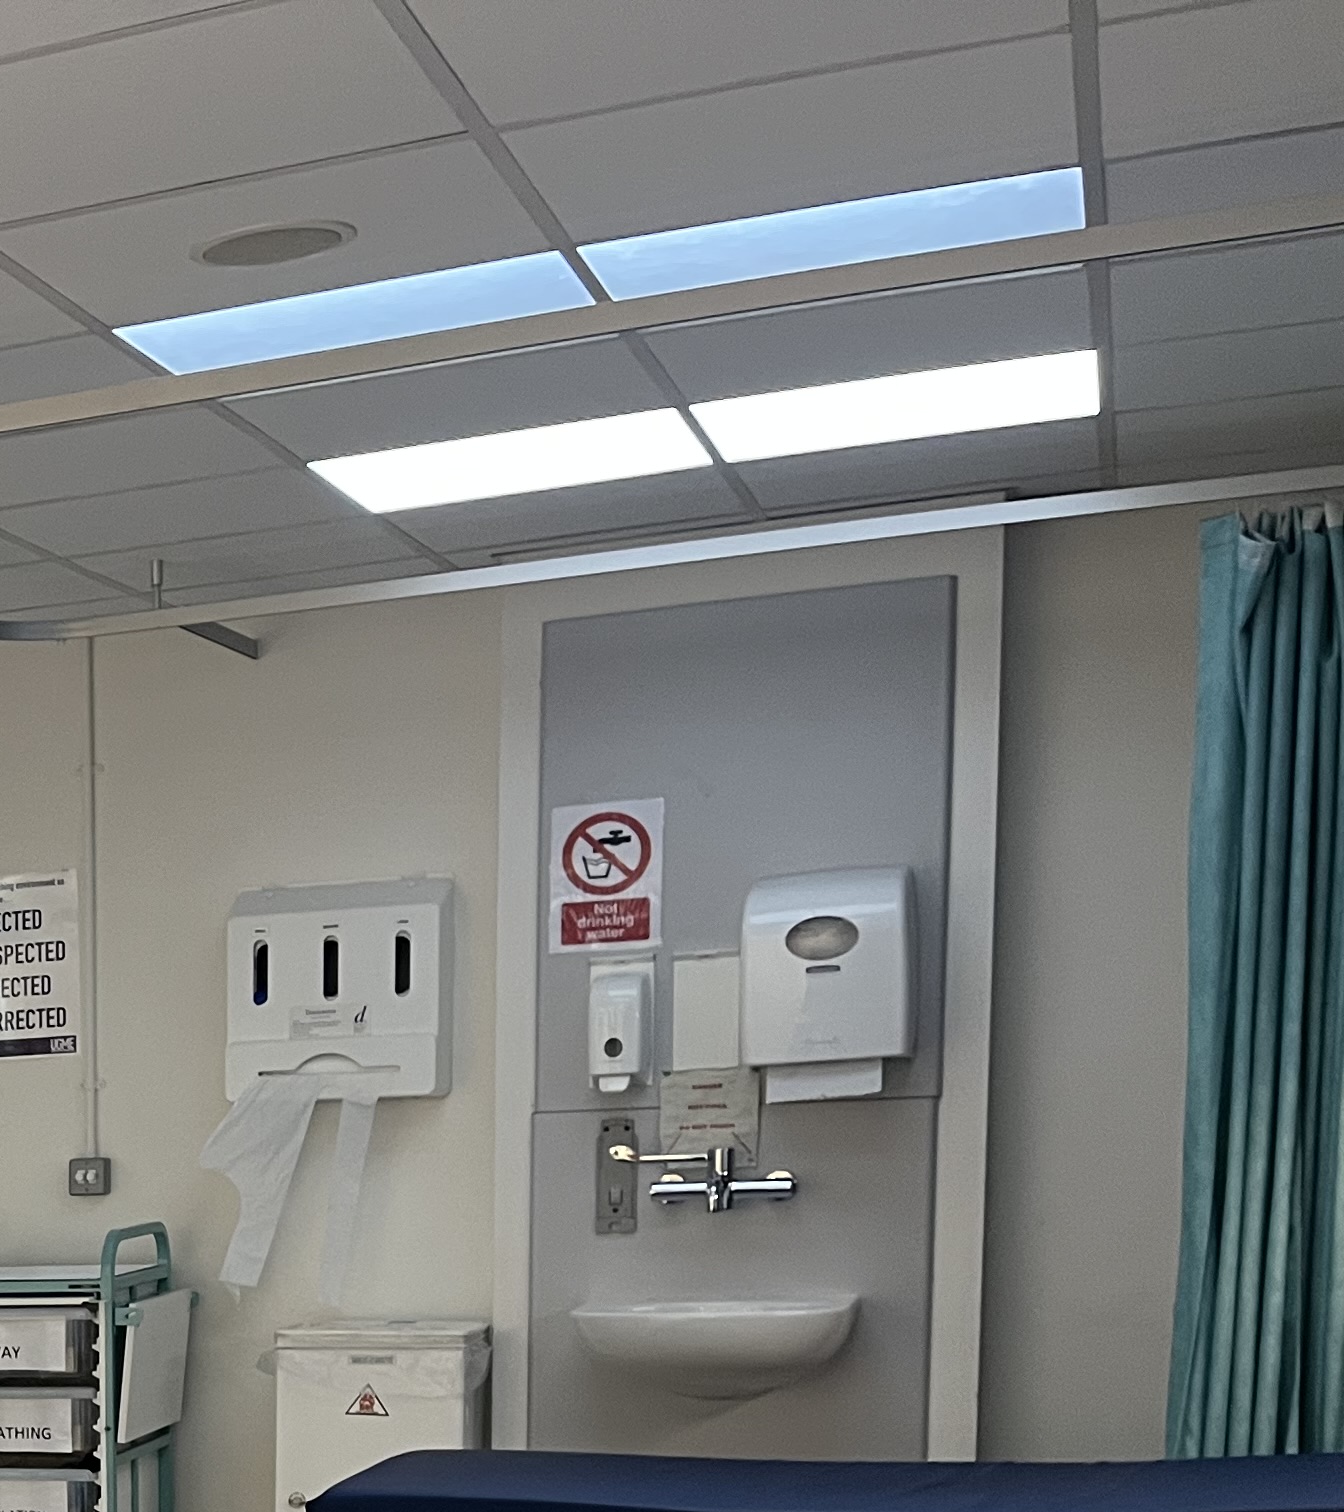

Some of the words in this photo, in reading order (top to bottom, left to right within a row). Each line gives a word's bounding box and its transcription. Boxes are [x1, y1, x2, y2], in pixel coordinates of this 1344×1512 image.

[593, 902, 618, 915] Not
[576, 914, 635, 929] drinking
[585, 928, 625, 941] water
